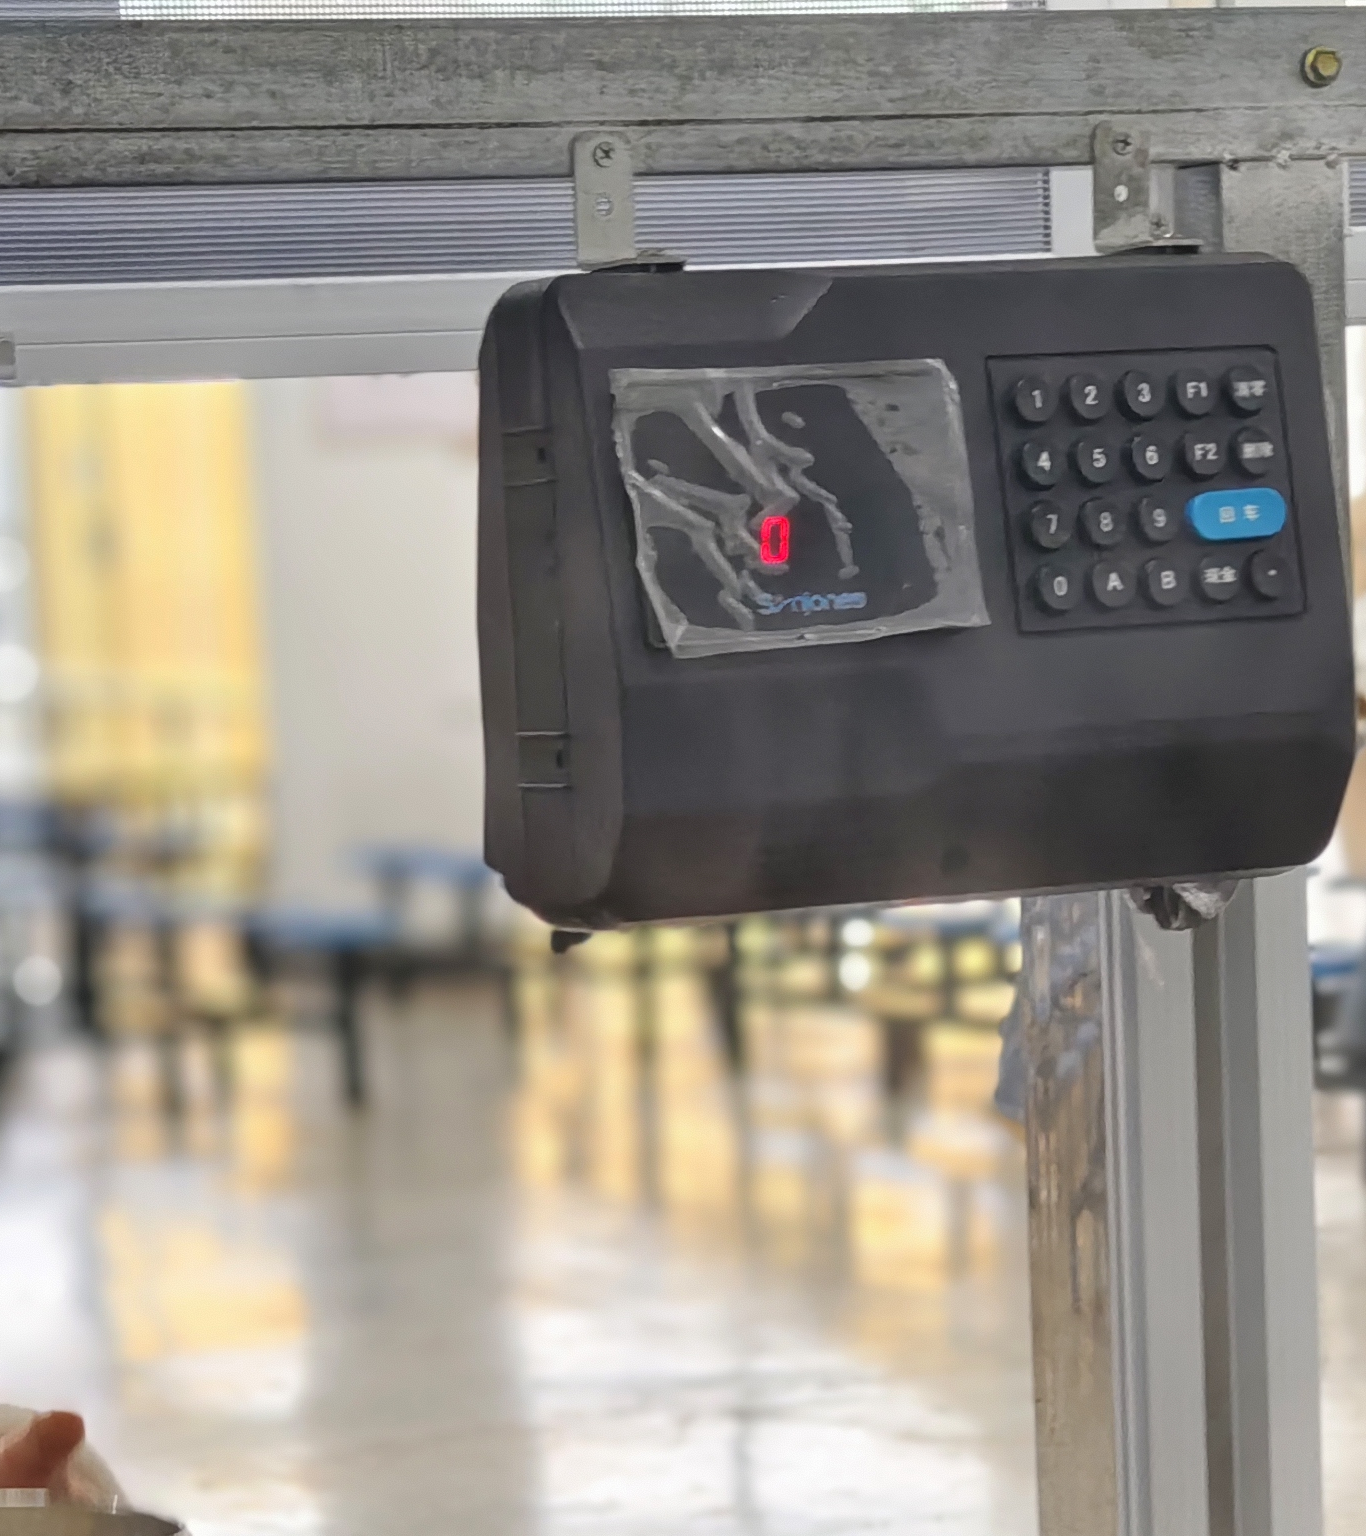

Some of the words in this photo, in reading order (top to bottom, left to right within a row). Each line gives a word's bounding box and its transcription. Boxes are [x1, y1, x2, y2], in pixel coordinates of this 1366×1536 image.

[1031, 389, 1043, 409] 1
[1083, 385, 1099, 405] 2
[1137, 382, 1152, 403] 3
[1186, 381, 1208, 399] F1
[1037, 451, 1052, 472] 4
[1092, 448, 1107, 468] 5
[1145, 445, 1159, 465] 6
[1194, 442, 1219, 461] F2
[1046, 513, 1059, 534] 7
[1099, 511, 1114, 532] 8
[1152, 508, 1167, 528] 9
[761, 516, 790, 564] 0
[1053, 576, 1068, 596] 0
[1106, 572, 1125, 591] A
[1160, 570, 1177, 589] B
